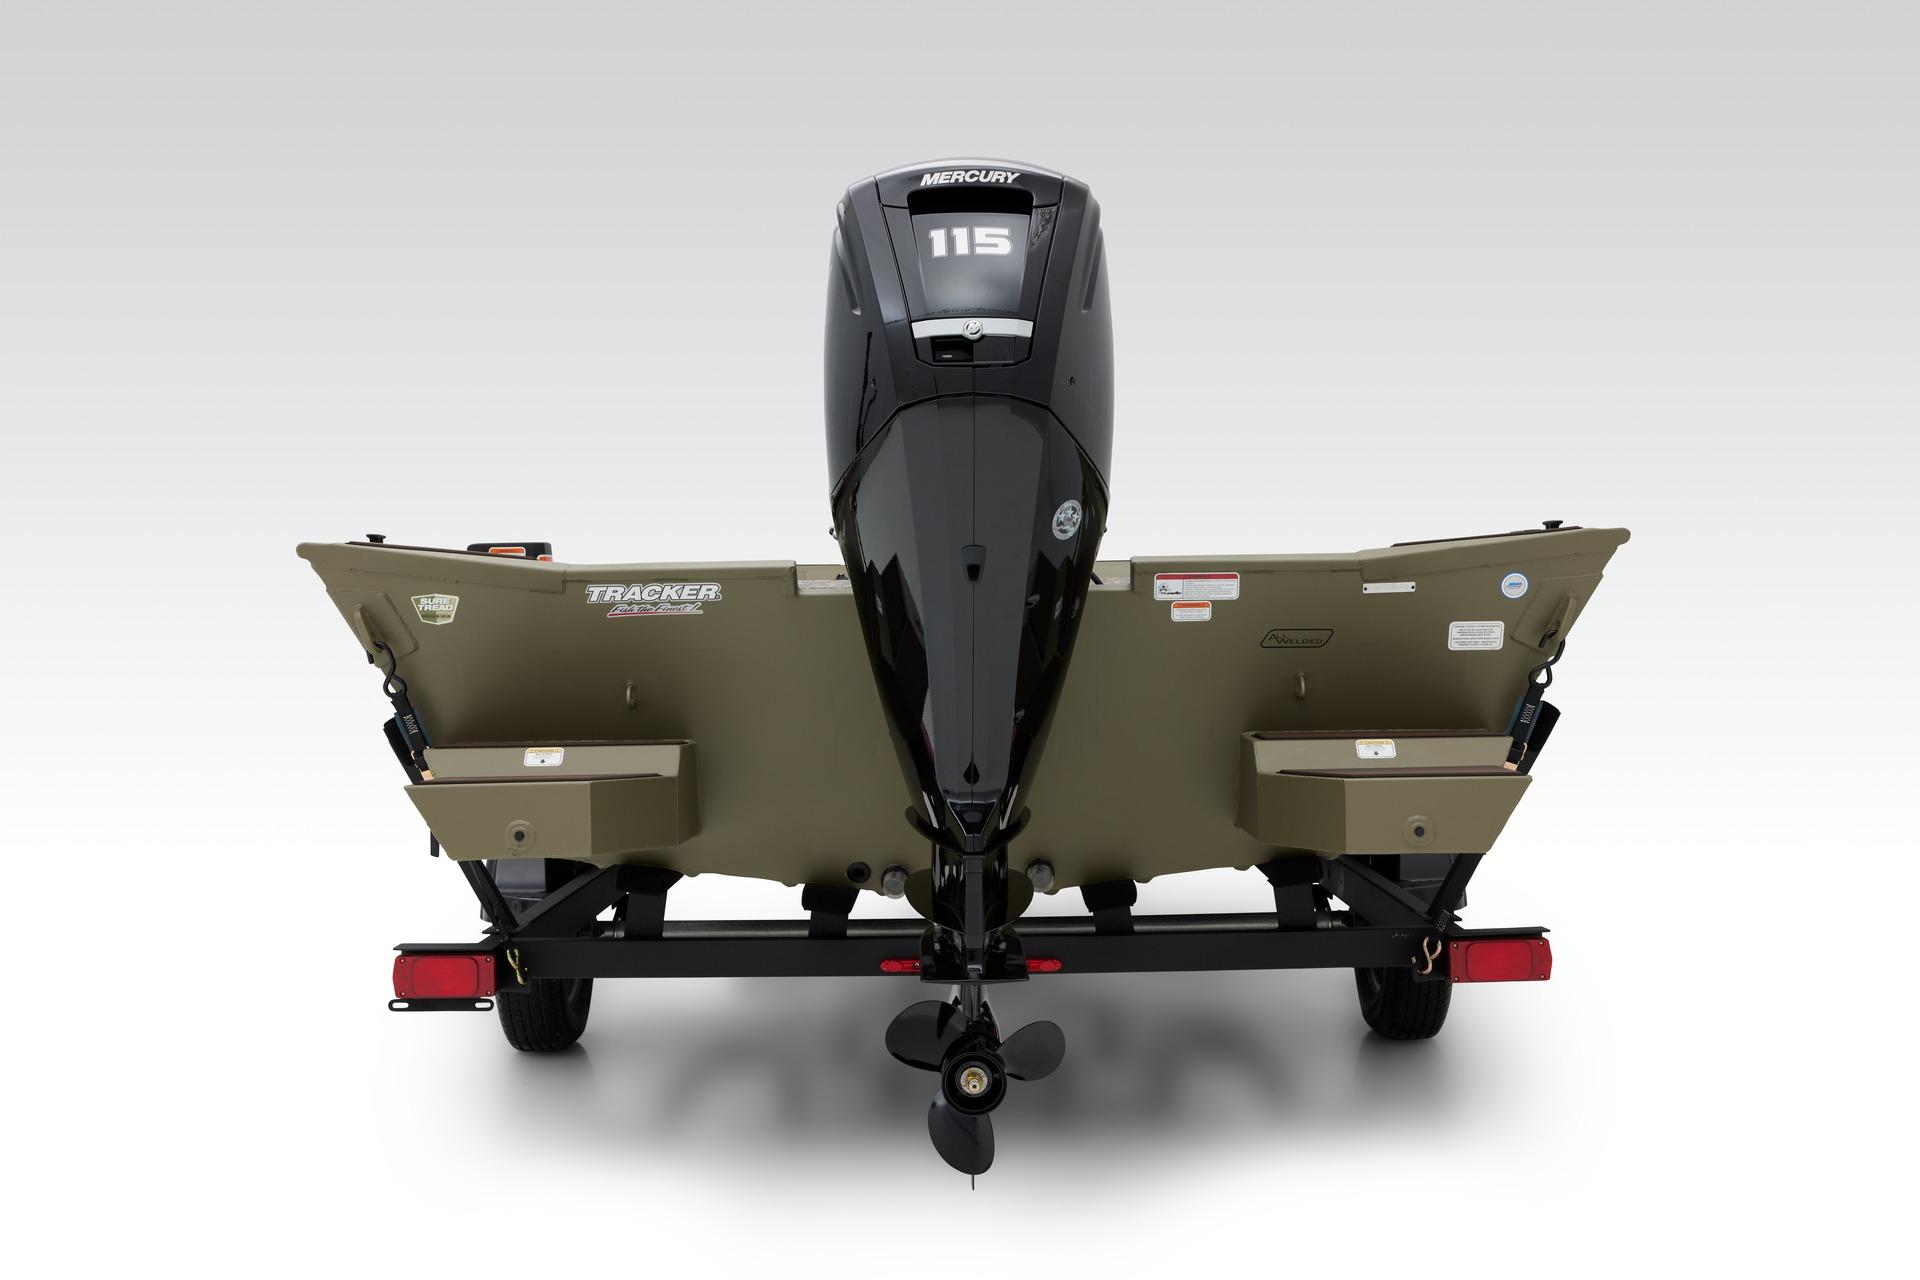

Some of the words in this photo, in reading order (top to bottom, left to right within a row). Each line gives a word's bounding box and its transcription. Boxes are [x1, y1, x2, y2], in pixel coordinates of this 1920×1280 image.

[920, 169, 1022, 187] MERCURY
[928, 226, 1013, 258] 115
[586, 583, 722, 603] TRACKER
[420, 597, 450, 605] SURE
[636, 604, 654, 612] the
[1268, 633, 1289, 641] ALL
